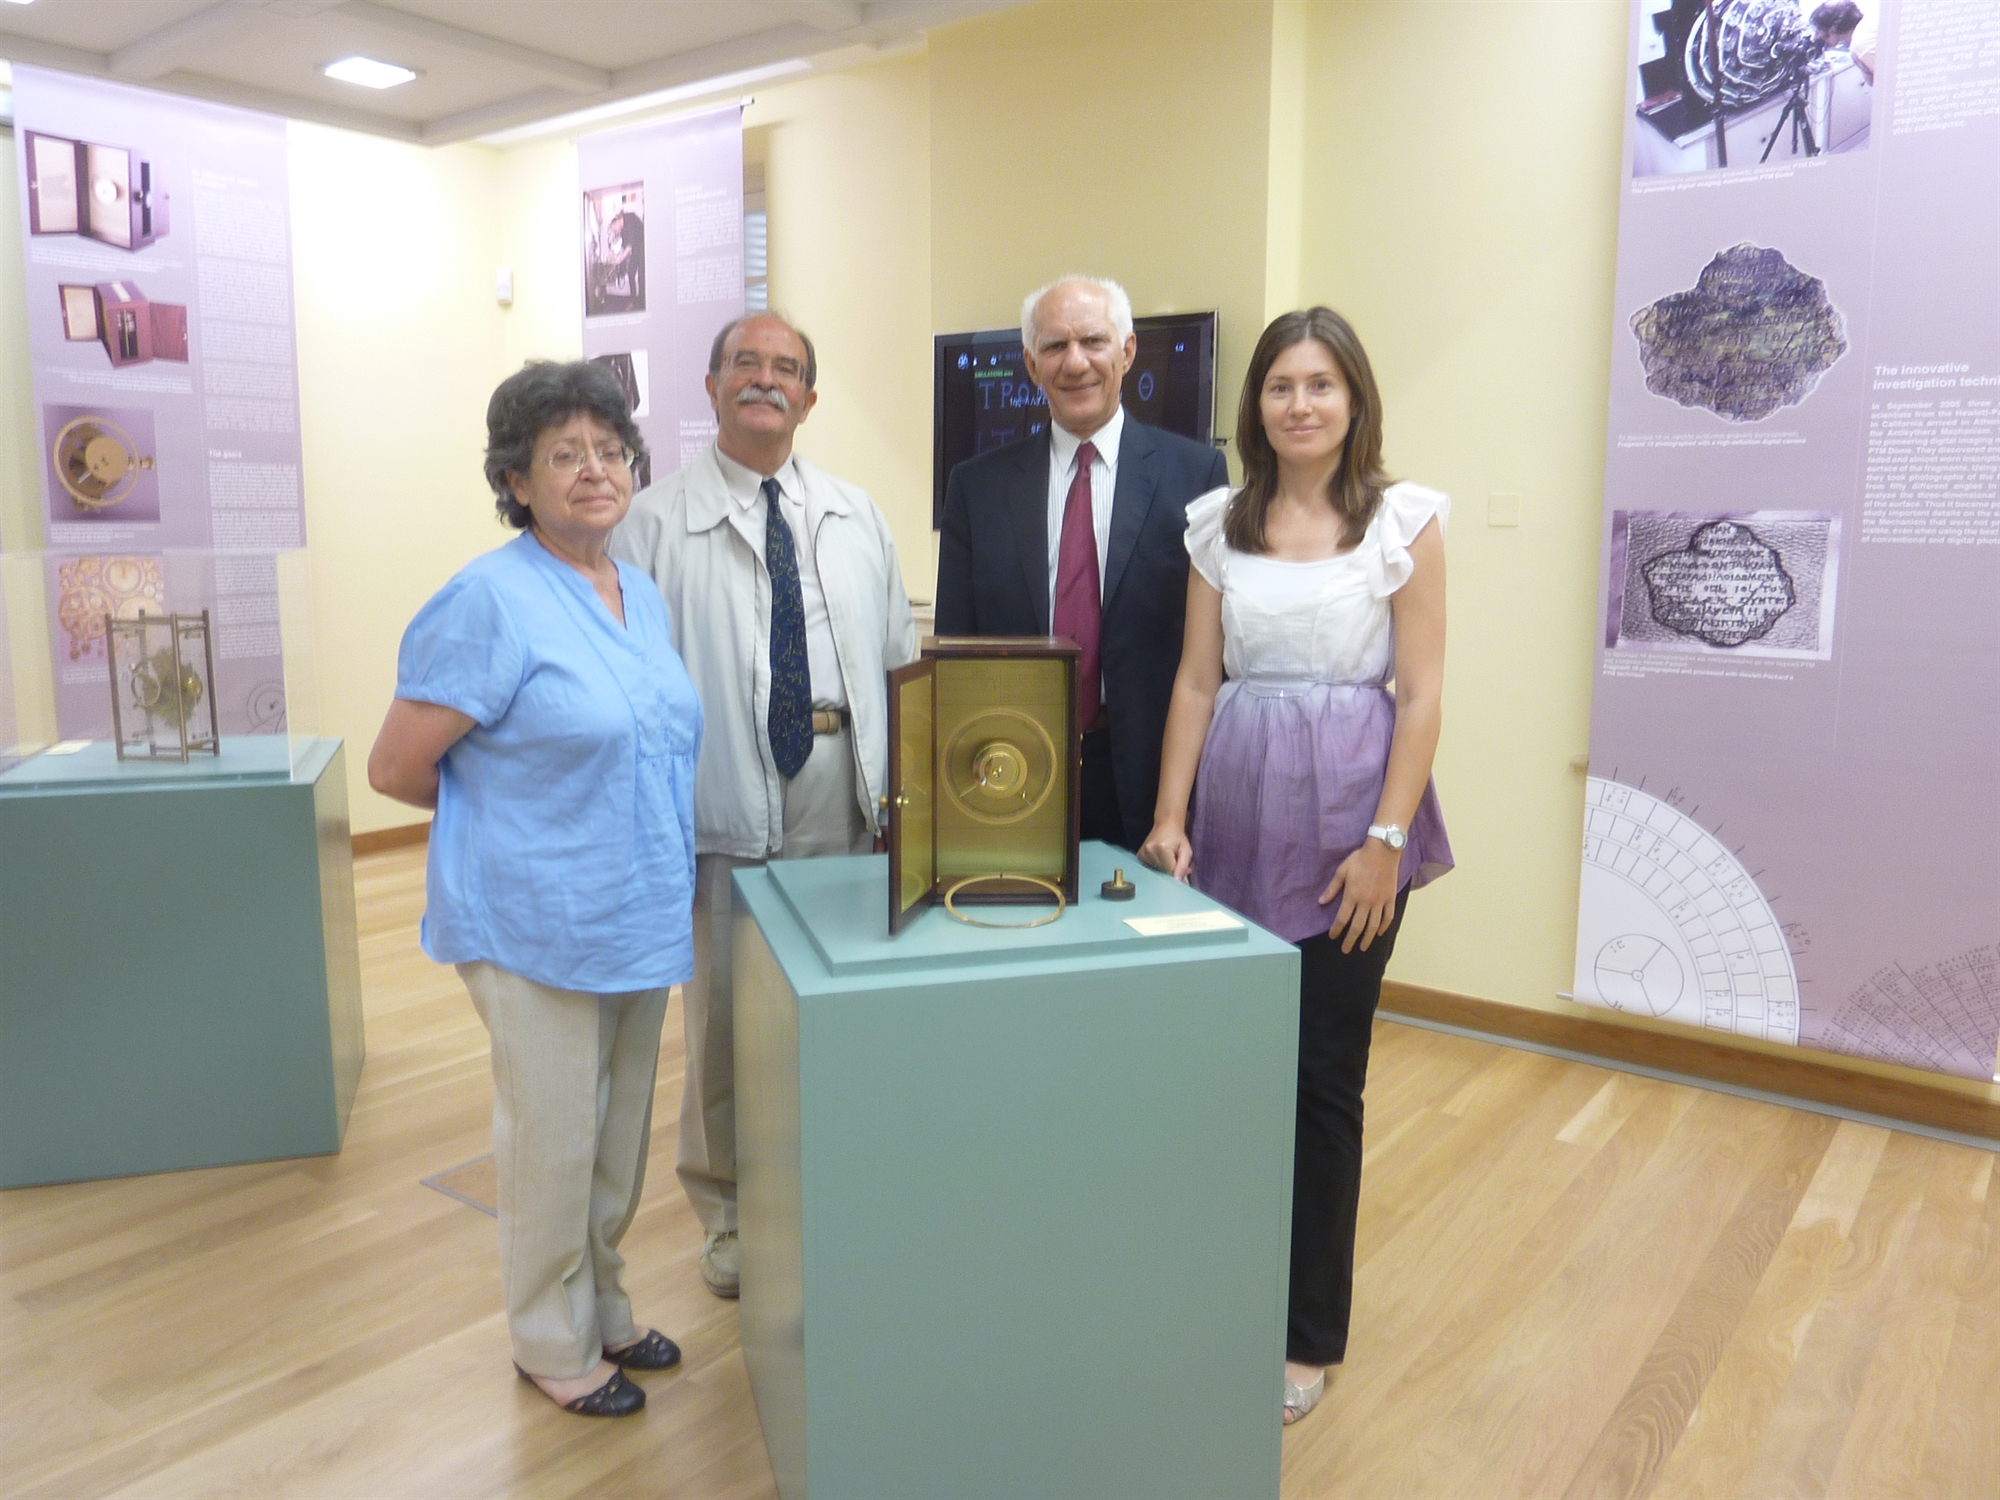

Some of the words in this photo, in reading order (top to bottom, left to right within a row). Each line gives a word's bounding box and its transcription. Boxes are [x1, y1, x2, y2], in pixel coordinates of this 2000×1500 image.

[1874, 365, 1898, 376] The
[1902, 363, 1969, 375] innovative
[1873, 377, 1956, 391] investigation
[1887, 401, 1933, 410] September
[1882, 420, 1923, 428] California
[1887, 429, 1936, 438] Antikythera
[1884, 438, 1928, 447] pioneering
[1930, 437, 1957, 446] digital
[1958, 437, 1992, 445] imaging
[1916, 447, 1937, 455] They
[1972, 464, 1997, 473] Using
[1909, 474, 1963, 482] photographs
[1954, 483, 1982, 491] angles
[1863, 510, 1886, 518] study
[1889, 510, 1930, 518] important
[1938, 528, 1962, 536] using
[1947, 537, 1975, 545] digital
